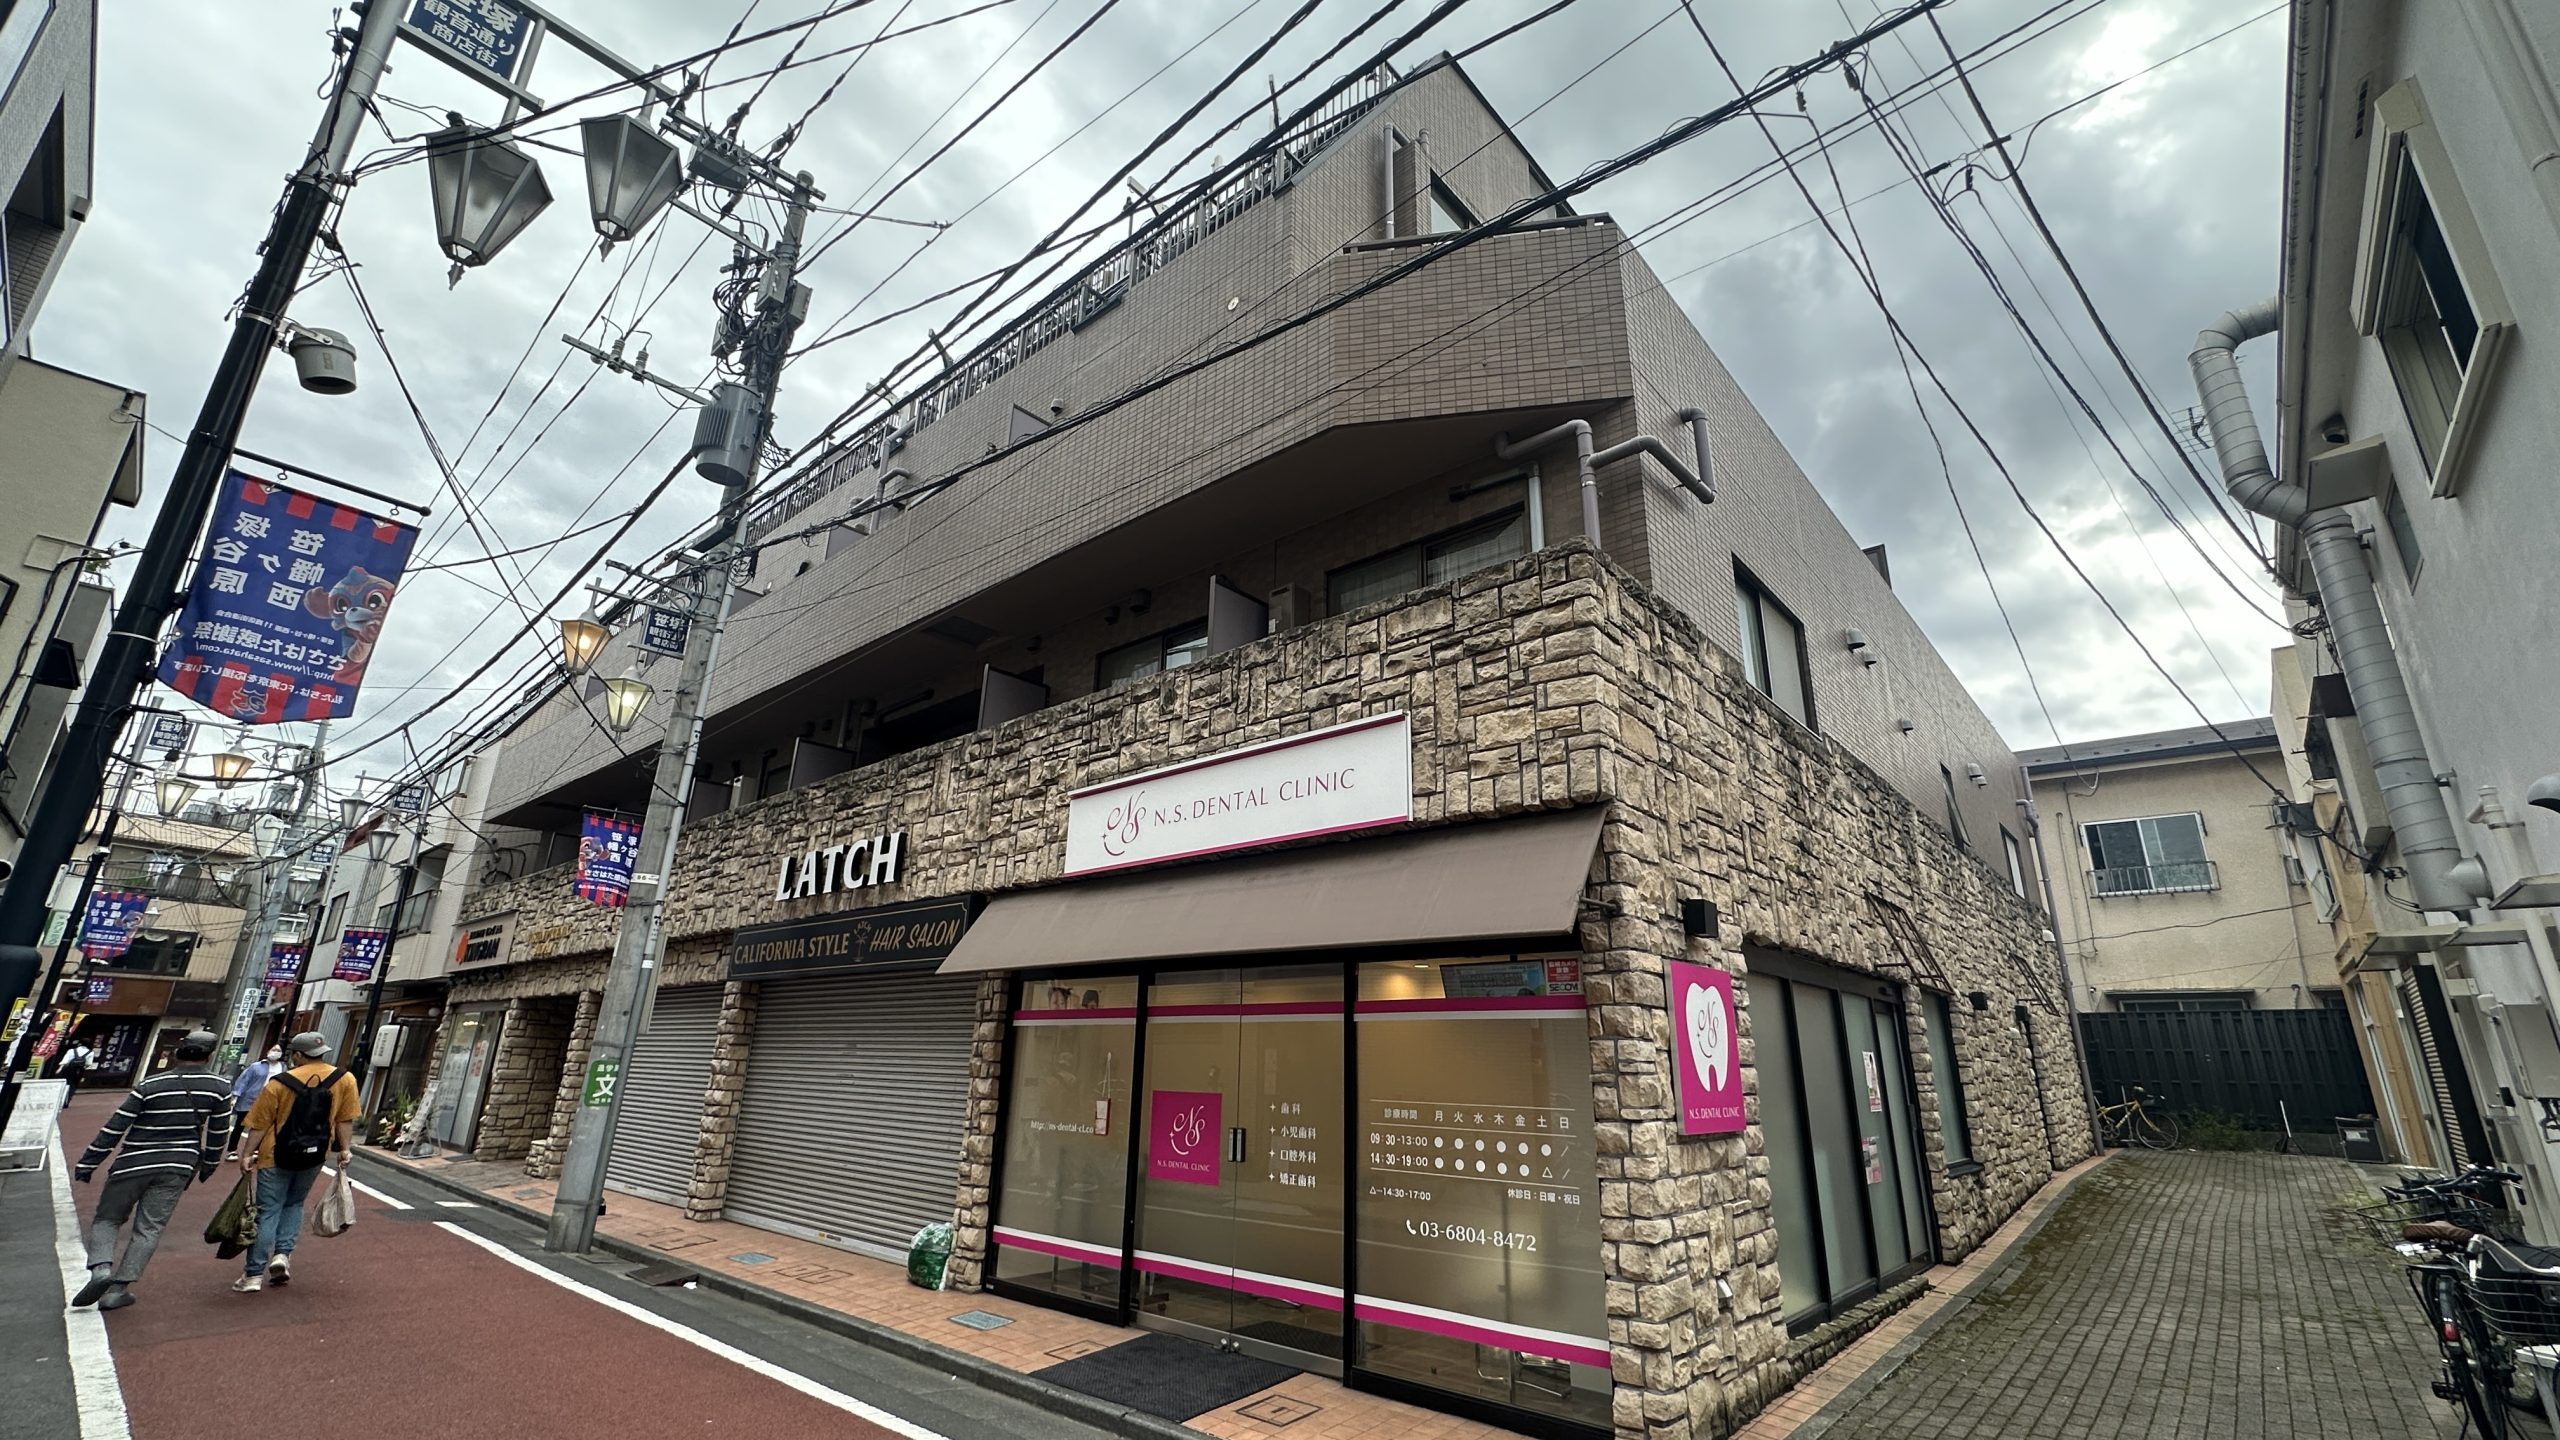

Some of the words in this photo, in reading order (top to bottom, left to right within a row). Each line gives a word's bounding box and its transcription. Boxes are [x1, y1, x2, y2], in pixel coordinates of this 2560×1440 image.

[423, 0, 515, 55] 観音通り
[431, 21, 499, 68] 商店街
[1153, 804, 1188, 827] N.S.
[1193, 787, 1269, 819] DENTAL
[1279, 768, 1355, 801] CLINIC
[776, 832, 904, 901] LATCH
[734, 938, 804, 965] CALIFORNIA
[808, 933, 850, 958] STYLE
[869, 924, 904, 953] HAIR
[906, 918, 961, 949] SALON
[1549, 983, 1579, 992] SECOM
[592, 1074, 617, 1098] 文
[1384, 1107, 1418, 1120] 診療時間
[1434, 1110, 1443, 1122] 月
[1454, 1111, 1464, 1123] 火
[1473, 1112, 1484, 1124] 水
[1493, 1112, 1504, 1125] 木
[1514, 1114, 1526, 1127] 金
[1536, 1115, 1548, 1128] 土
[1559, 1116, 1569, 1129] 日
[1700, 1107, 1722, 1119] DENTAL
[1722, 1106, 1740, 1118] CLINIC
[1280, 1125, 1316, 1140] 小児歯科
[1168, 1160, 1189, 1170] DENTAL
[1190, 1163, 1210, 1172] CLINIC
[1280, 1149, 1316, 1164] 口腔外科
[1279, 1171, 1316, 1188] 矯正歯科
[1419, 1220, 1537, 1252] 03-6804-8472
